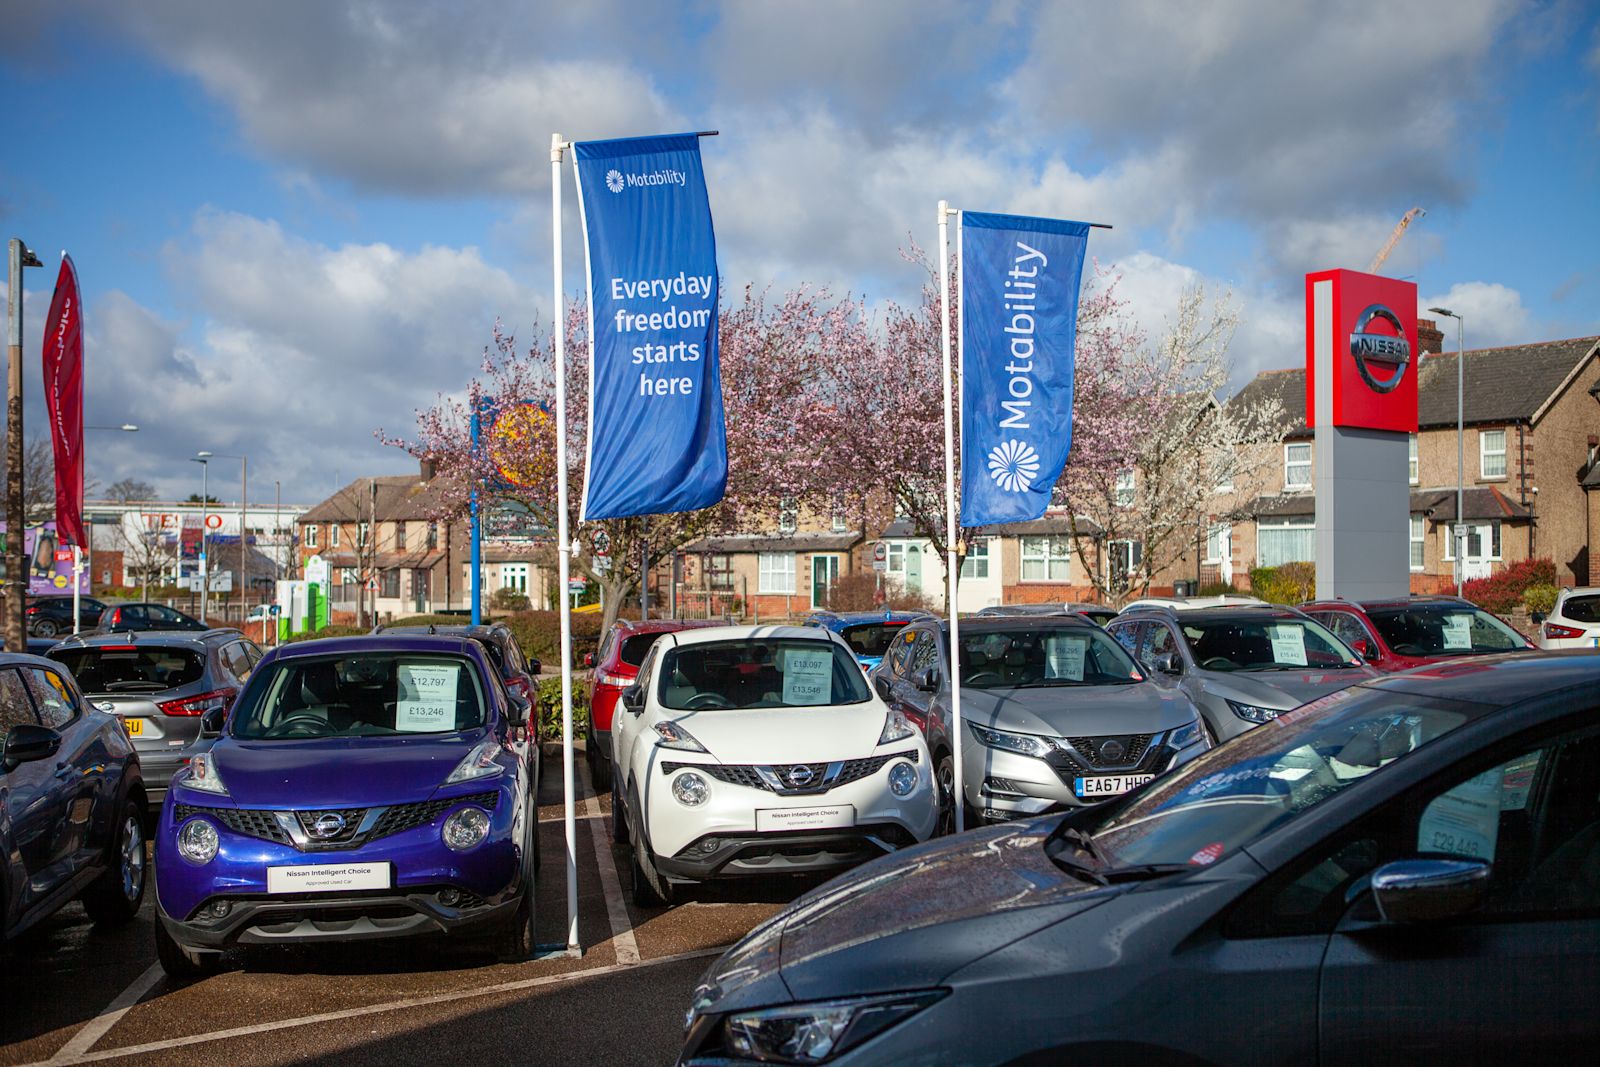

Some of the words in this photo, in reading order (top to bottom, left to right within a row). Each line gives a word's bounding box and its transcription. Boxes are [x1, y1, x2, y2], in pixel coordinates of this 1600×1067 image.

[626, 169, 687, 188] Motability
[611, 271, 713, 302] Everyday
[614, 305, 711, 333] freedom
[1000, 241, 1048, 429] Motability
[631, 341, 701, 365] starts
[1361, 337, 1408, 354] NISSAN
[639, 373, 693, 396] here
[141, 513, 223, 530] TEO
[410, 677, 447, 687] £12,797
[409, 706, 444, 716] £13,246
[1085, 778, 1121, 793] EA67
[791, 810, 819, 818] Intelligent
[311, 868, 347, 877] Intelligent
[347, 867, 371, 875] Choice
